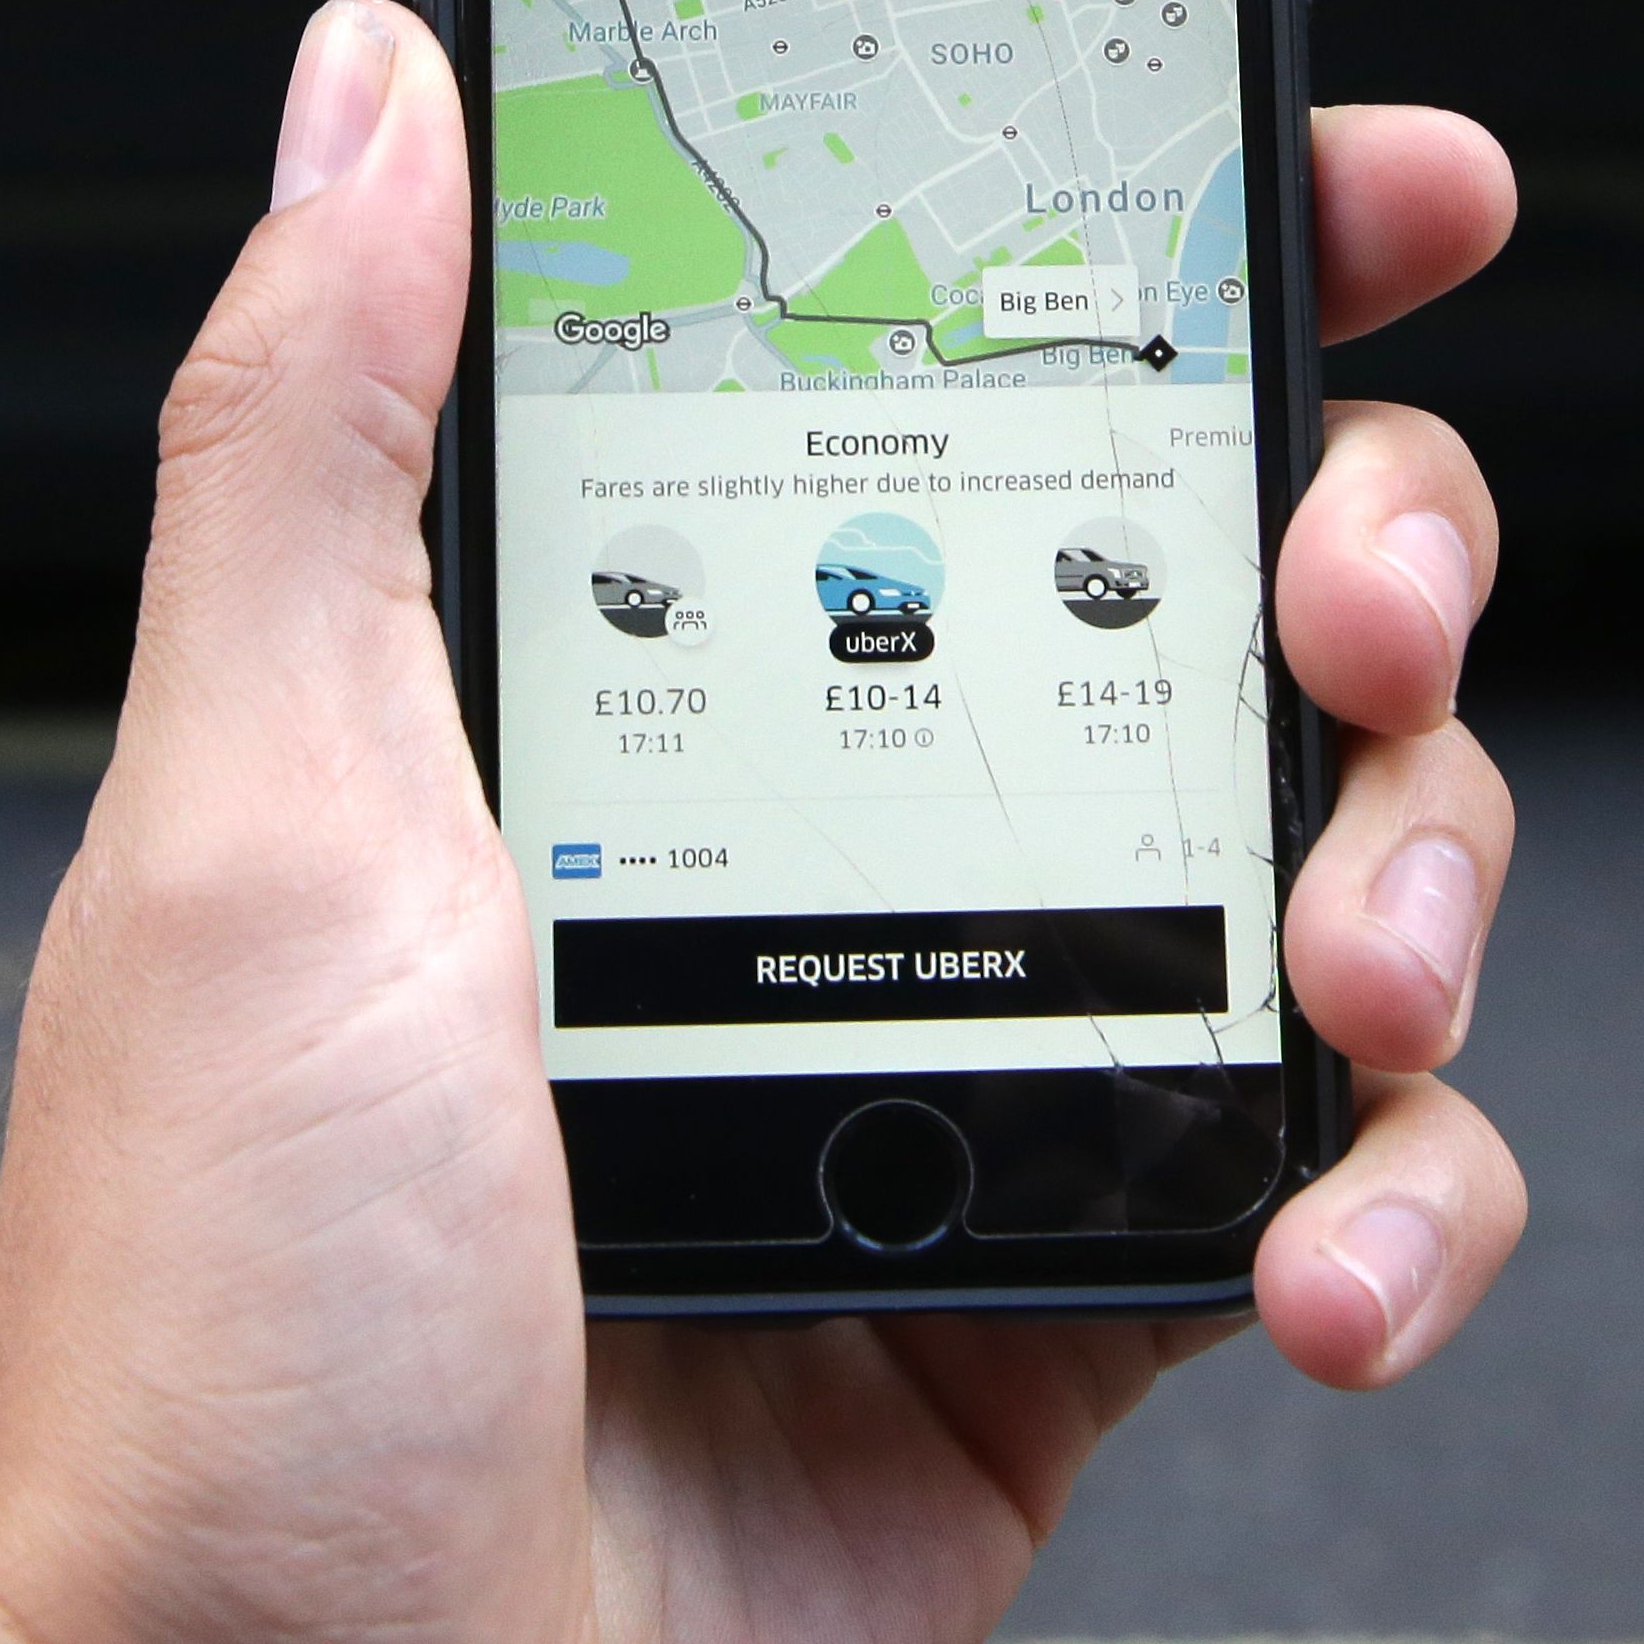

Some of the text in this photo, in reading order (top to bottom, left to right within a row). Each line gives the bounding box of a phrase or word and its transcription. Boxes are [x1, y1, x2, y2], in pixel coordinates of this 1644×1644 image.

[569, 20, 718, 43] Marble Arch
[930, 42, 1014, 65] SOHO
[759, 92, 857, 112] MAYFAIR
[1026, 181, 1185, 214] London
[494, 195, 605, 224] yde Park
[931, 284, 984, 306] Coc
[999, 292, 1089, 315] Big Ben
[1166, 281, 1208, 307] Eye
[556, 311, 670, 349] Google
[1043, 345, 1135, 369] Big Ben
[780, 369, 1026, 391] Buckingham Palace
[806, 430, 950, 458] Economy
[1170, 424, 1252, 447] Premiu
[581, 467, 1175, 500] Fares are slightly higher due to increased demand
[845, 631, 918, 654] uberX
[594, 688, 707, 717] £10.70
[825, 683, 943, 712] £10-14
[1057, 679, 1173, 707] £14-19
[618, 733, 685, 754] 17:11
[839, 728, 907, 750] 17:10
[1084, 723, 1151, 745] 17:10
[668, 847, 729, 869] 1004
[1183, 837, 1221, 858] 1-4
[756, 950, 1027, 987] REQUEST UBERX
